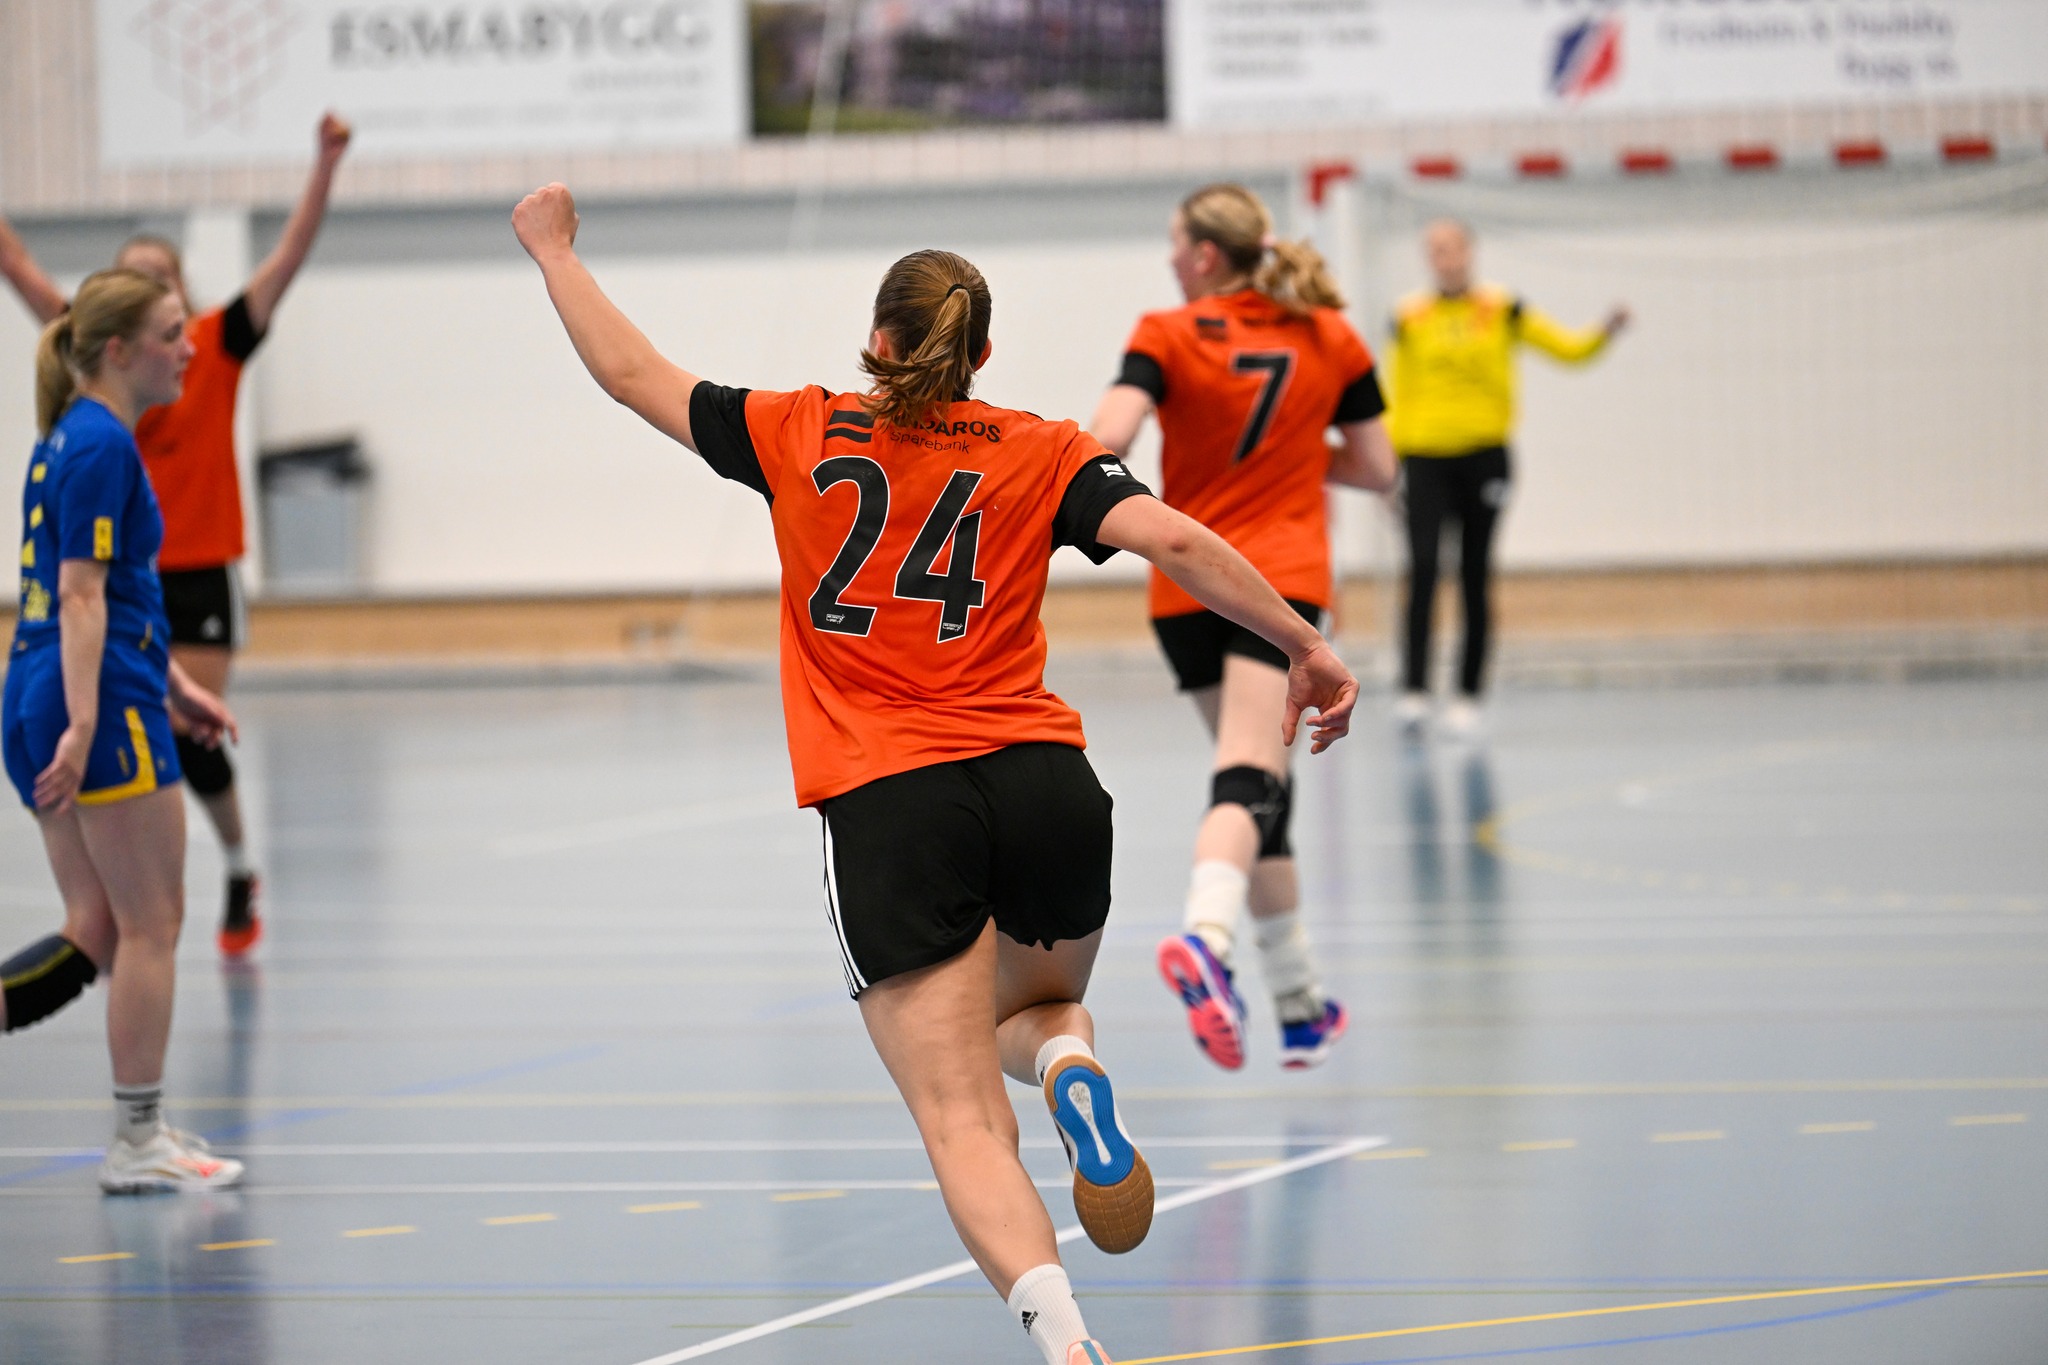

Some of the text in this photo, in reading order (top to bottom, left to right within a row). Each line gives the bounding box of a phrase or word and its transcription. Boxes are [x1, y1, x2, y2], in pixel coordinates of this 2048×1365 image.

[329, 3, 713, 67] ESMABYGG
[1231, 348, 1298, 466] 7
[809, 456, 986, 643] 24
